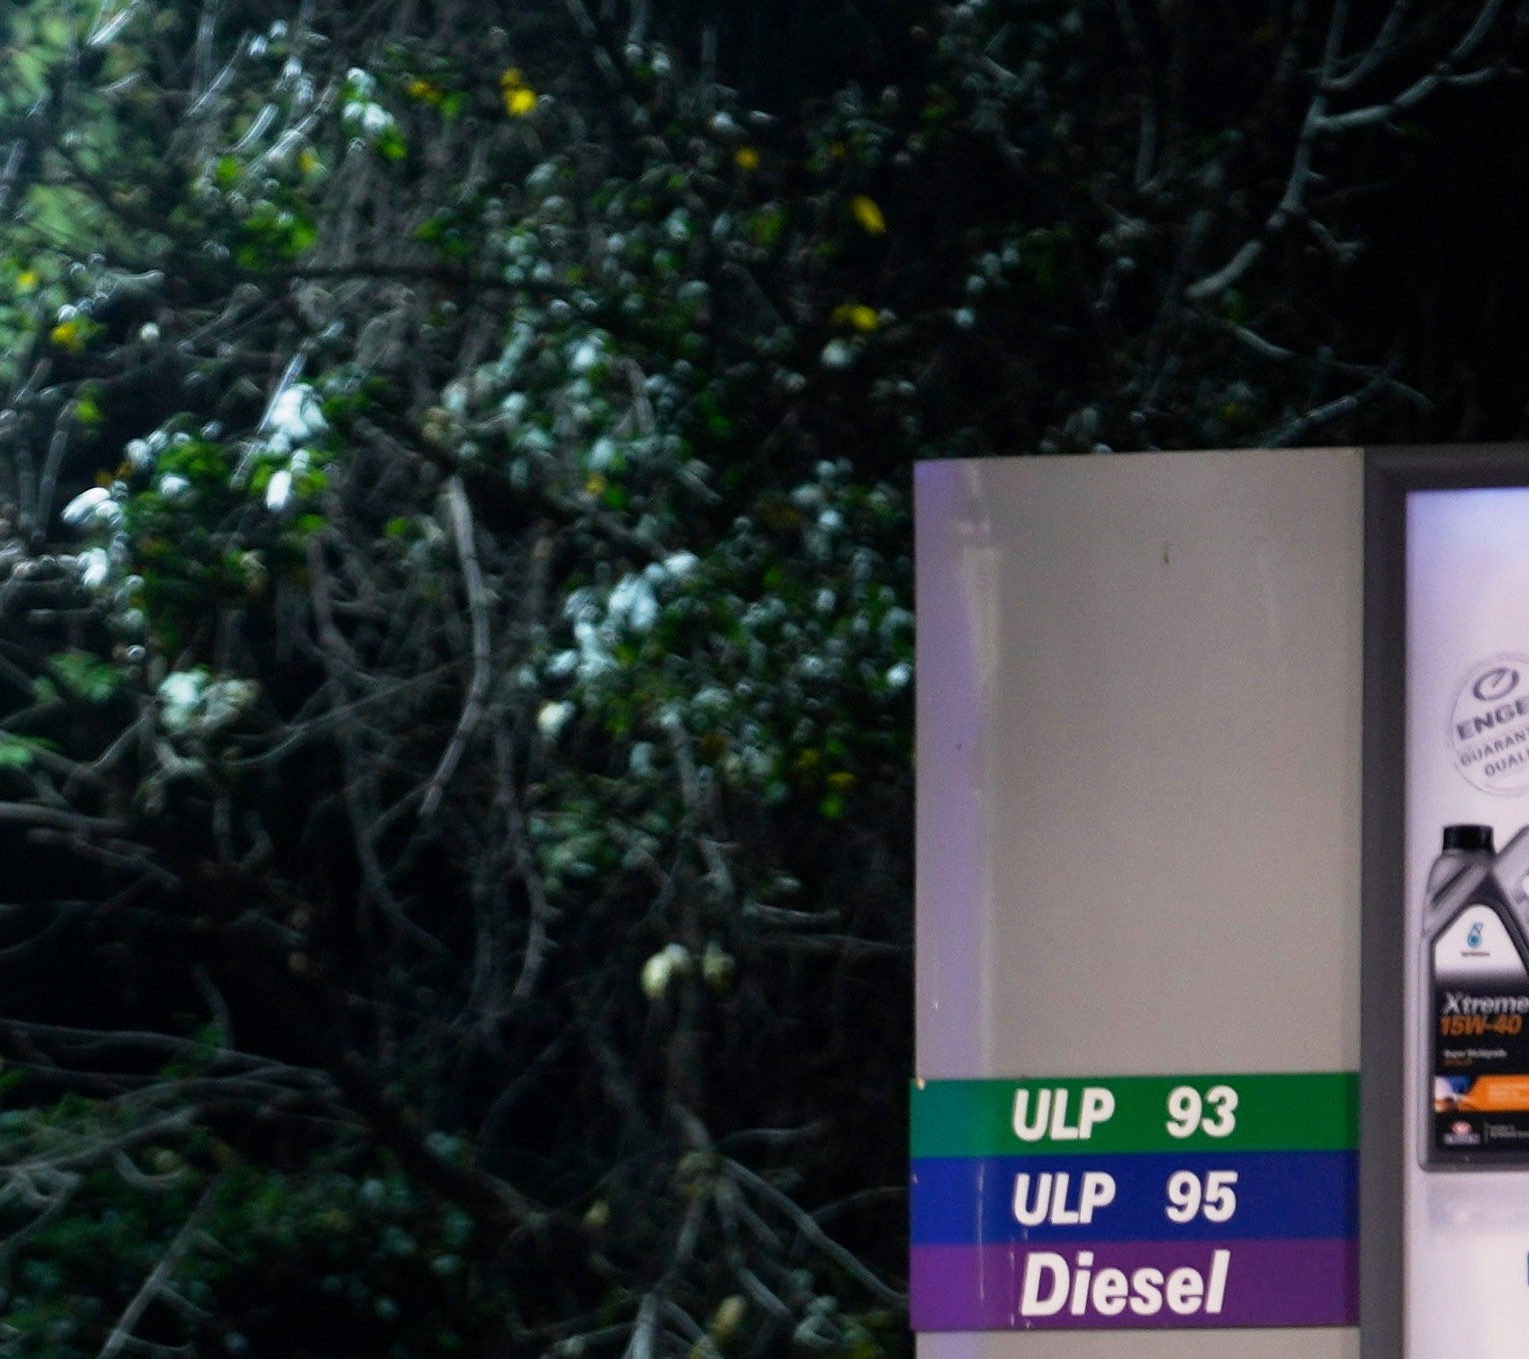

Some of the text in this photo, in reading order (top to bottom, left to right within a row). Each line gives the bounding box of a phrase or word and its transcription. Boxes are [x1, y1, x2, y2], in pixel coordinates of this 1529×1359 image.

[1439, 1014, 1523, 1036] 15W-40
[1012, 1087, 1239, 1141] ULP 93
[1012, 1171, 1239, 1225] ULP 95
[1021, 1251, 1230, 1317] Diesel
